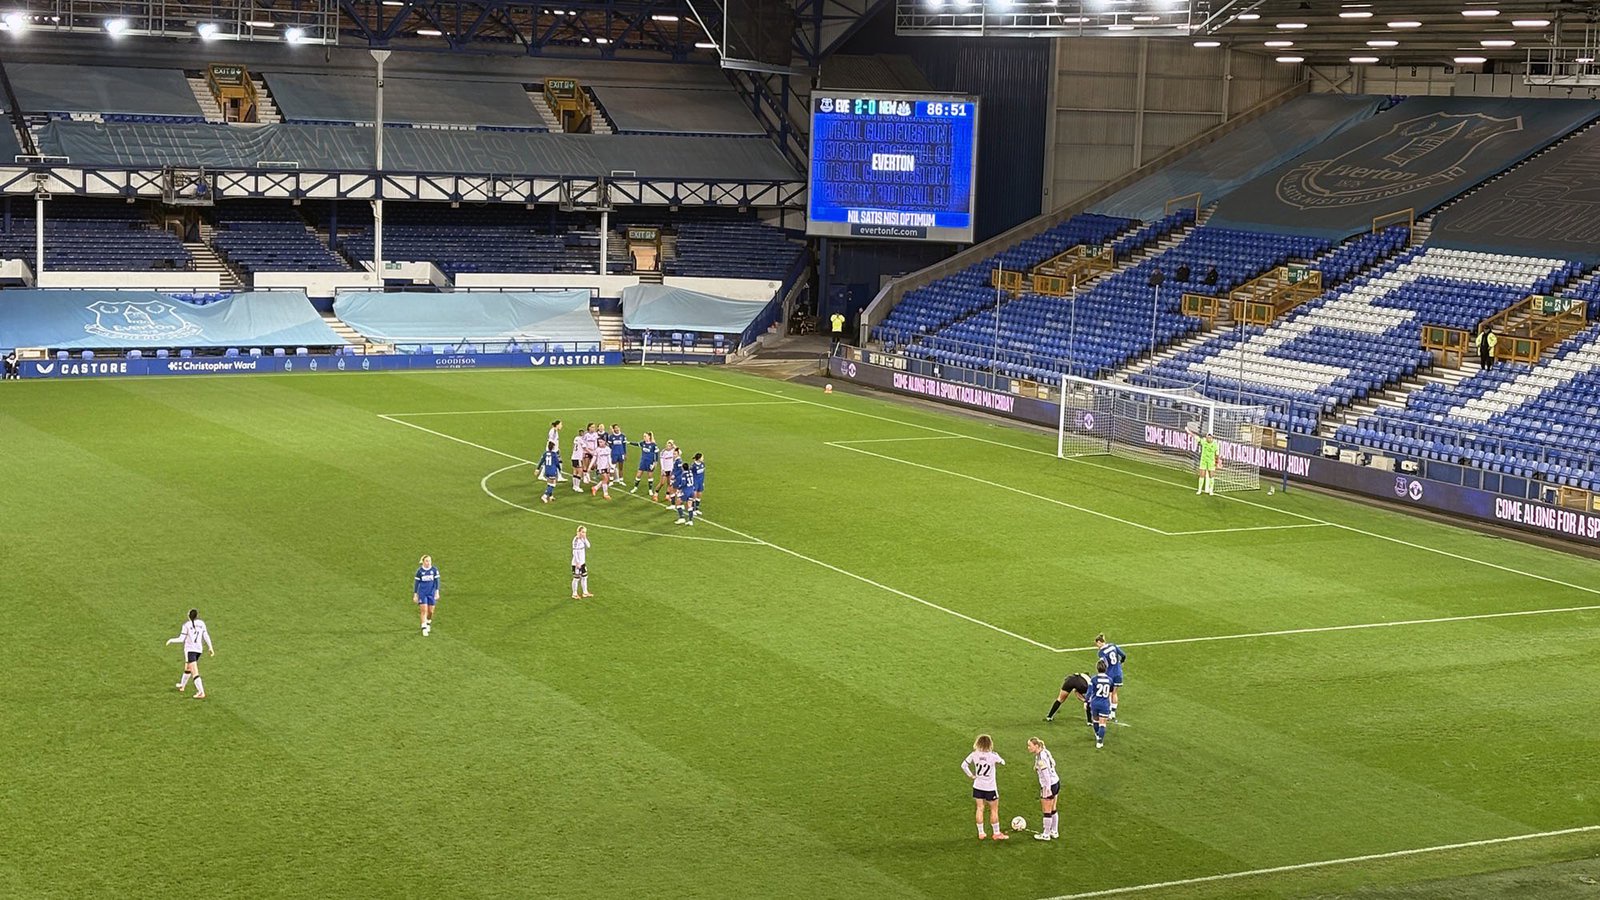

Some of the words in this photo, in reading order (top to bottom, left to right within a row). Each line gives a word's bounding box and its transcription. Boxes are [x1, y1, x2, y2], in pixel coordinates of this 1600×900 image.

[549, 81, 564, 89] EXIT
[835, 99, 850, 113] EVE
[854, 99, 876, 115] 2-0
[878, 100, 897, 115] NEW
[926, 102, 967, 116] 86:51
[872, 153, 915, 172] EVERTON
[1326, 164, 1418, 182] Everton
[1338, 181, 1431, 205] OPTIMUM
[847, 210, 860, 223] NIL
[860, 211, 883, 225] SATIS
[883, 212, 899, 226] NISI
[899, 213, 936, 227] OPTIMUM
[860, 227, 918, 236] evertonfc.com
[183, 361, 233, 372] Christopher
[233, 361, 256, 370] Ward
[550, 355, 605, 365] CASTORE
[61, 363, 128, 375] CASTORE
[893, 372, 909, 389] COME
[908, 375, 926, 394] ALONG
[925, 378, 936, 396] FOR
[936, 381, 941, 397] A
[940, 382, 982, 406] SPOOKTACULAR
[982, 389, 1015, 413] MATCHDAY
[1145, 425, 1164, 446] COME
[1164, 429, 1187, 450] ALONG
[1495, 498, 1522, 523] COME
[1523, 503, 1556, 530] ALONG
[1556, 510, 1577, 534] FOR
[1577, 515, 1586, 537] A
[1109, 651, 1117, 665] 8
[1096, 683, 1110, 699] 29
[976, 763, 991, 777] 22
